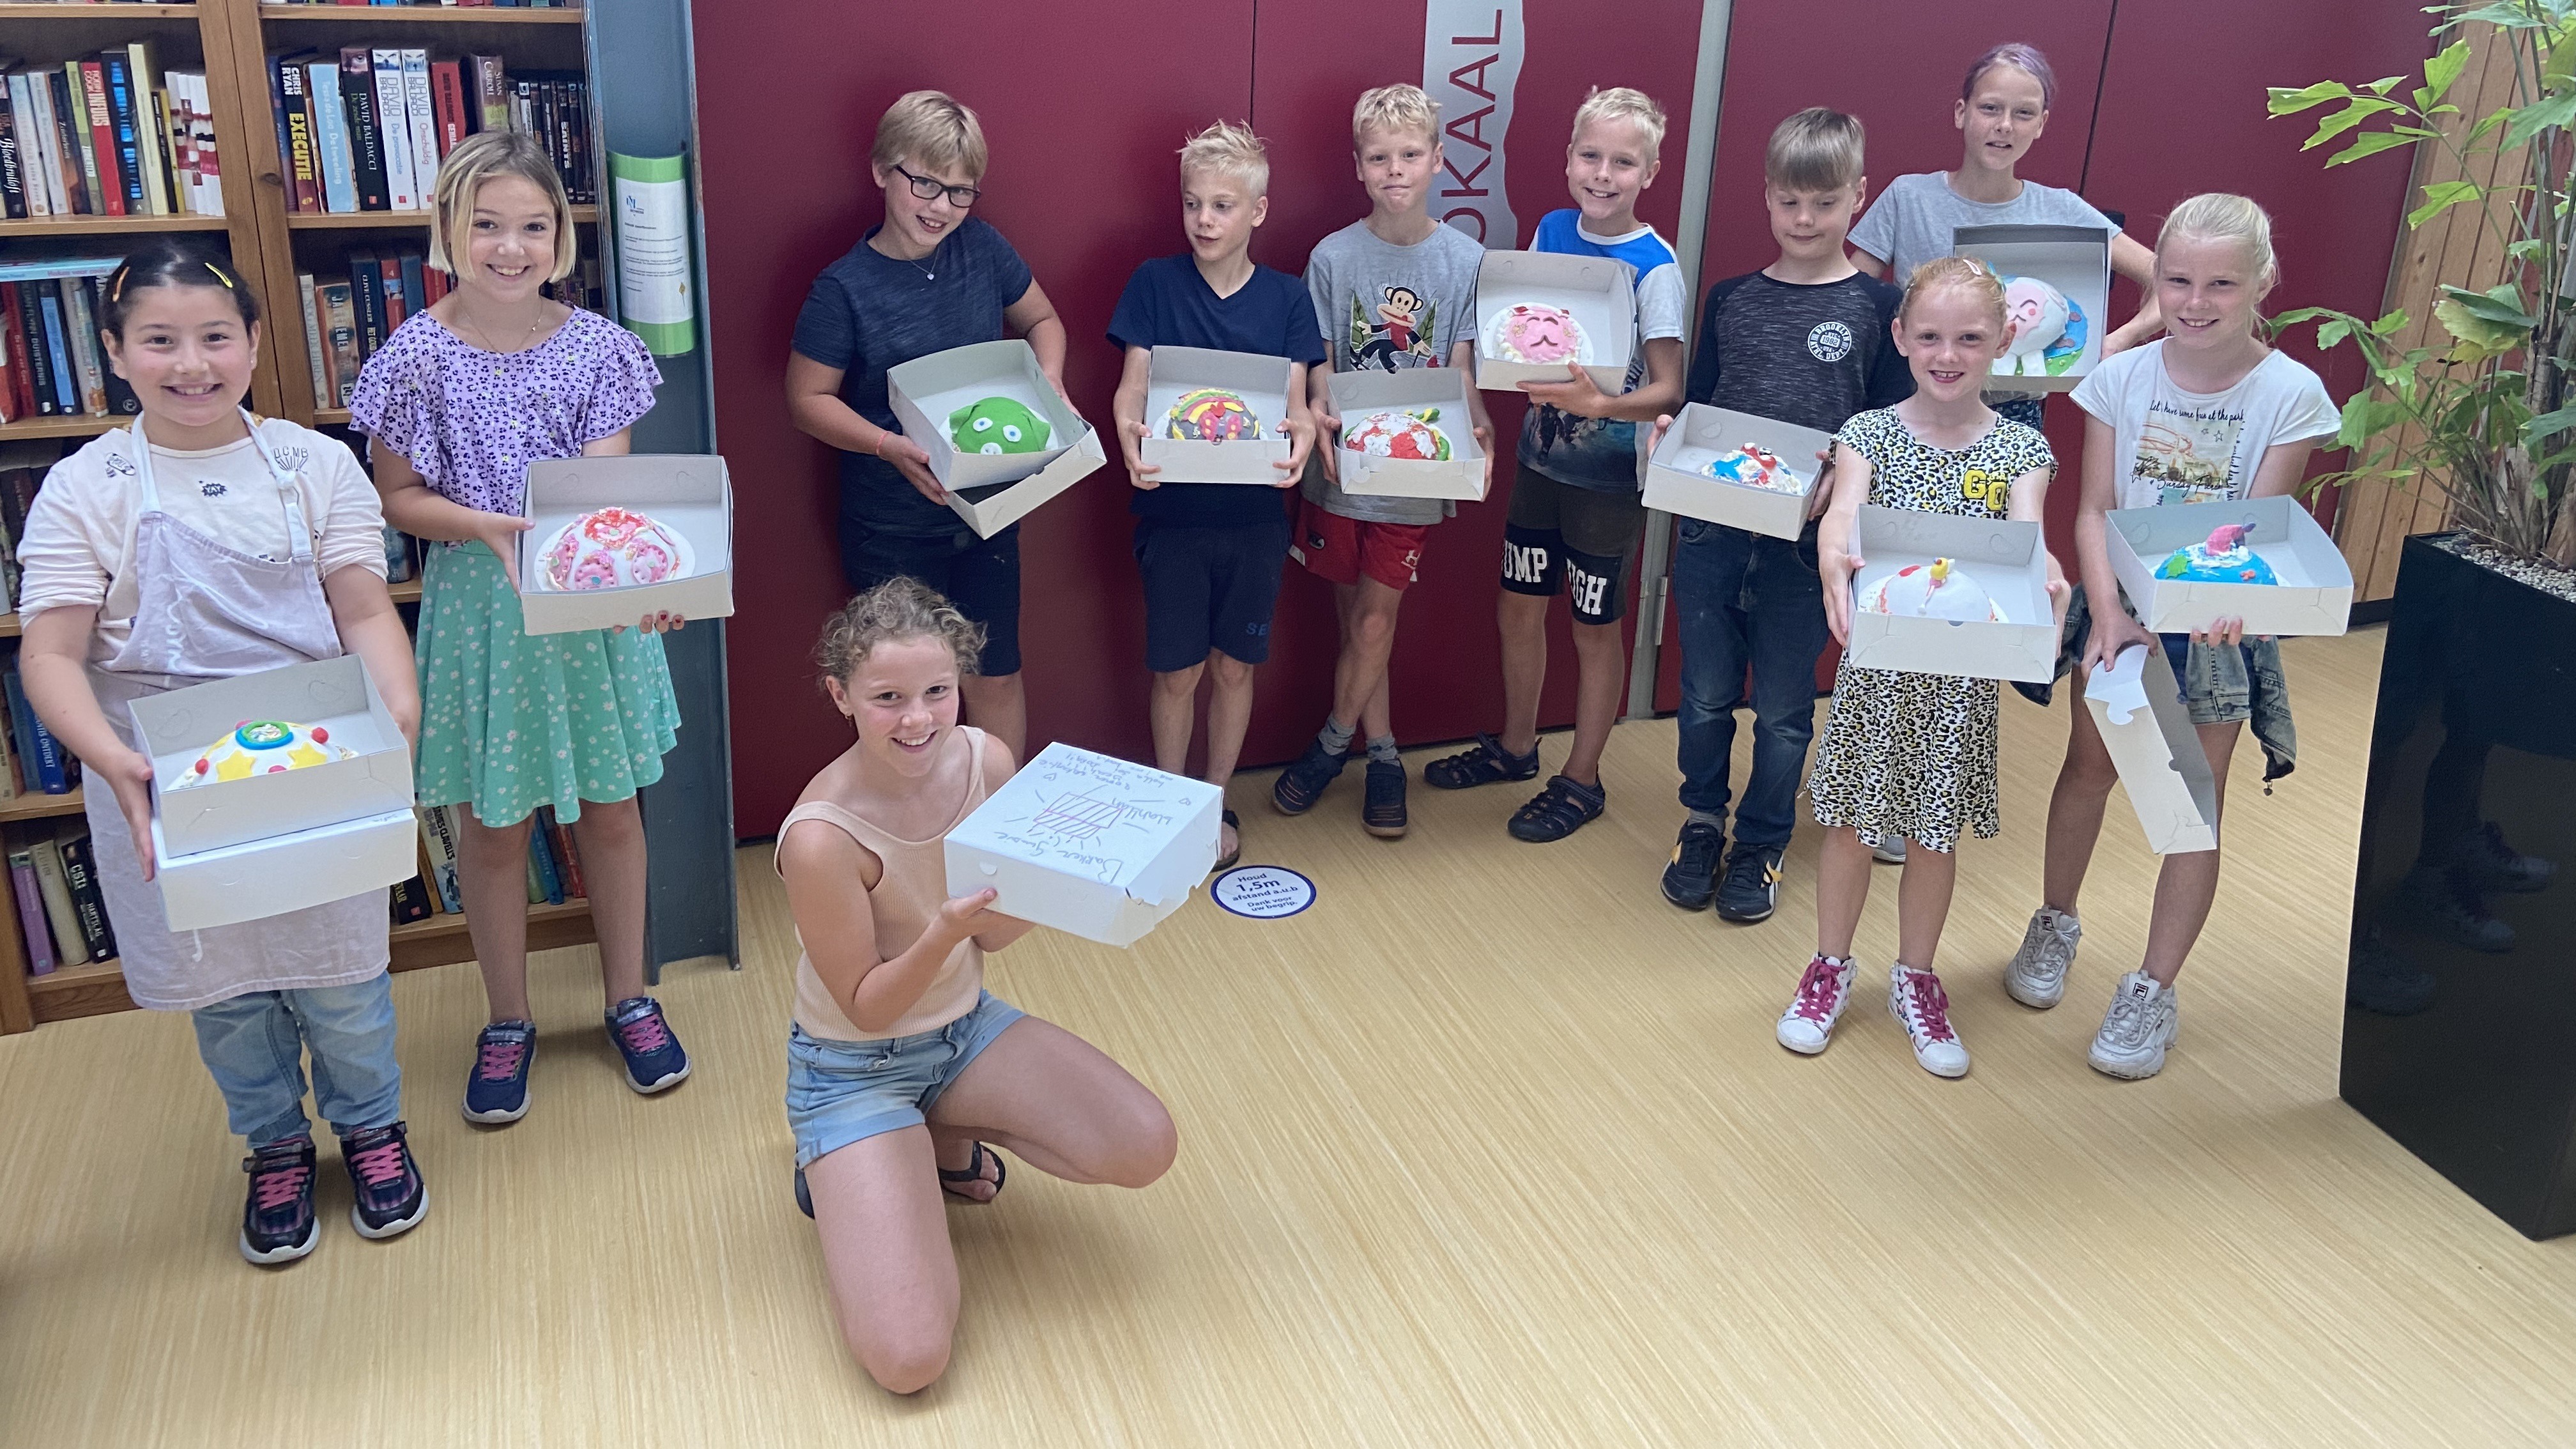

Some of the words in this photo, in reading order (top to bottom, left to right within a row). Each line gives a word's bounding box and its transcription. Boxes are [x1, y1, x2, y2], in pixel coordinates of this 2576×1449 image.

[282, 67, 295, 95] RYAN
[291, 67, 303, 95] CHRIS
[484, 61, 494, 96] CARROLL
[88, 93, 111, 126] INFUUS
[358, 93, 370, 123] DAVID
[379, 77, 390, 116] BALDACCI
[387, 77, 402, 116] DAVID
[408, 77, 418, 116] BALDACCI
[415, 77, 430, 116] DAVID
[391, 123, 400, 134] De
[419, 123, 431, 165] Onschuldig
[561, 121, 571, 169] SAINTS
[289, 113, 312, 180] EXECUTIE
[363, 125, 376, 171] BALDACCI
[1, 137, 22, 194] Bloedbruiloft
[1815, 323, 1850, 341] BROOKLYN
[1822, 336, 1838, 346] 1982
[1963, 470, 2007, 510] GO
[1501, 540, 1547, 583] UMP
[440, 825, 456, 860] CLAVELL'S
[1236, 879, 1280, 892] 1,5m
[1238, 873, 1268, 882] Houd
[1232, 890, 1271, 901] afstand
[1247, 898, 1271, 907] Dank
[1266, 901, 1298, 910] begrip.
